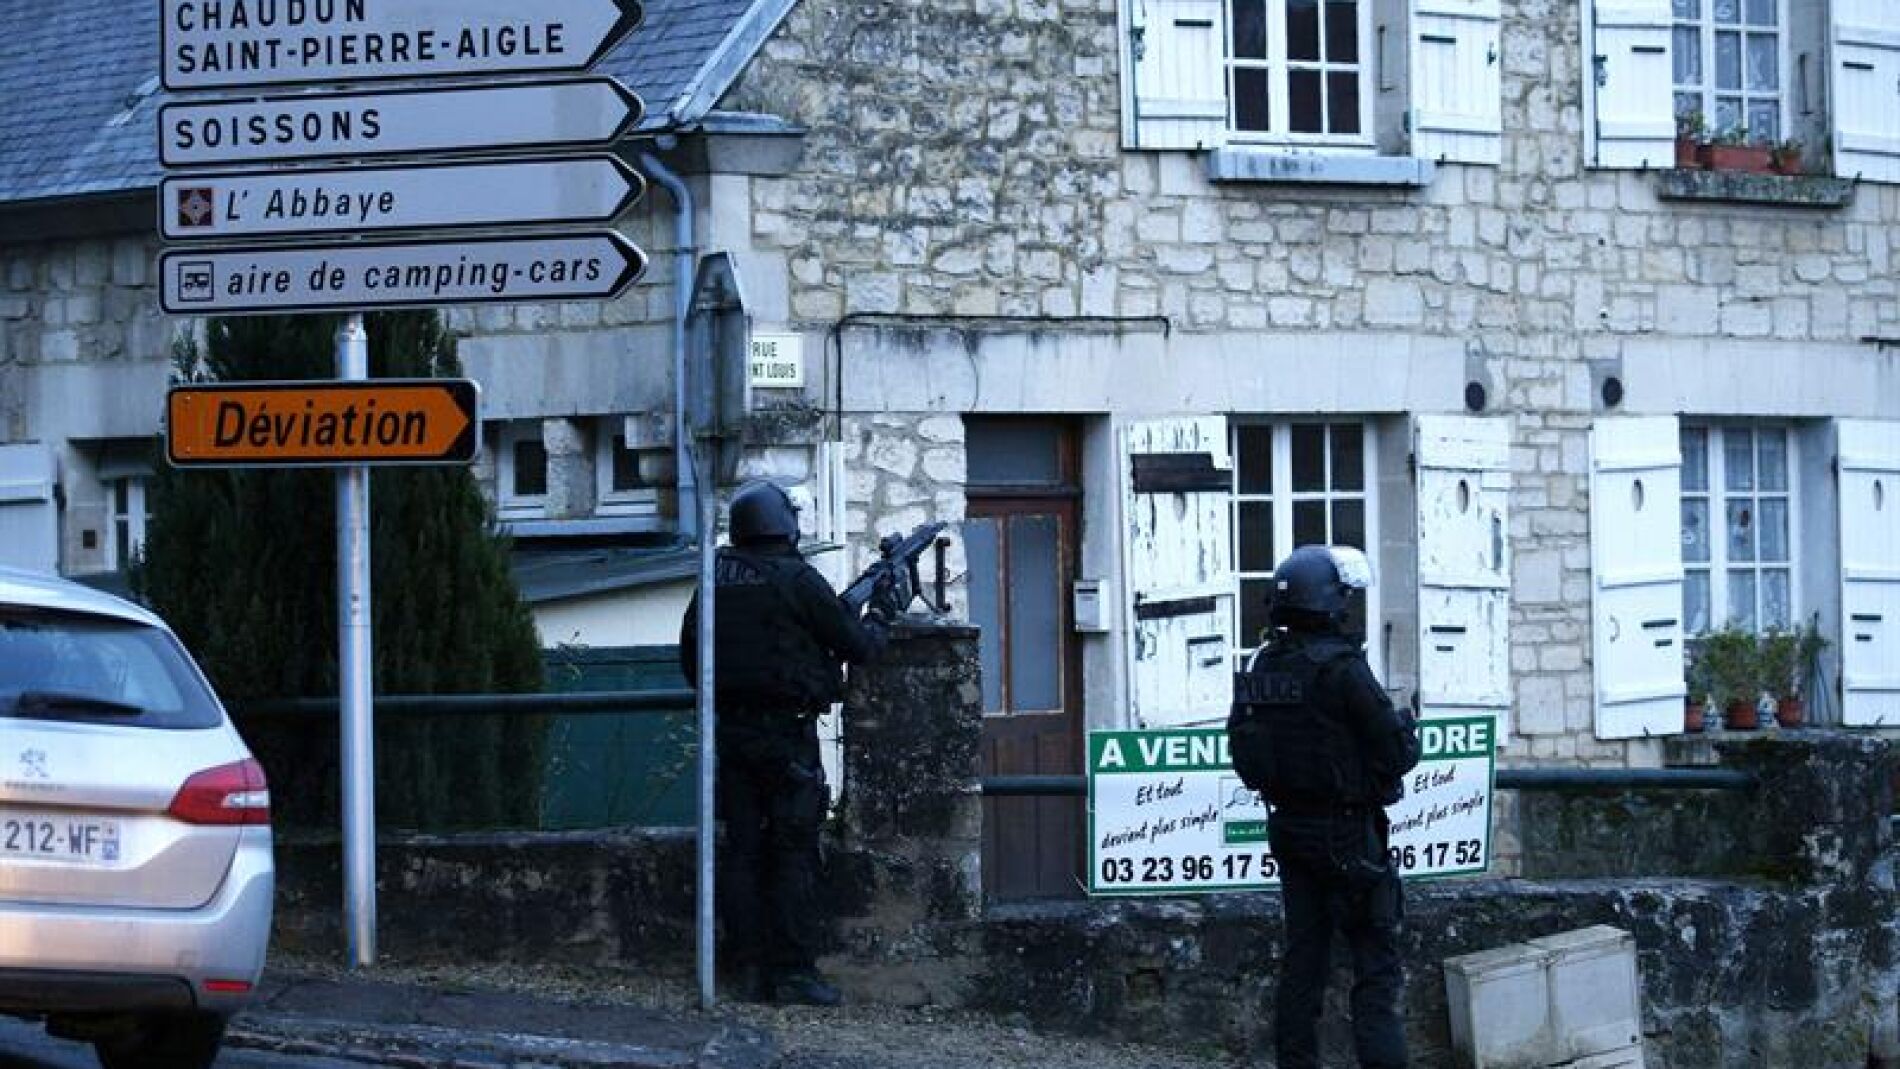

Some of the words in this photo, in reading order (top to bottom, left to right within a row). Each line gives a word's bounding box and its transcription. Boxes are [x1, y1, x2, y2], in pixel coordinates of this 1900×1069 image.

[177, 0, 365, 31] CHAUDUN
[177, 23, 565, 73] SAINT-PIERRE-AIGLE
[175, 108, 382, 149] SOISSONS
[226, 189, 249, 221] L'
[264, 187, 395, 222] Abbaye
[227, 264, 291, 295] aire
[309, 260, 345, 291] de
[364, 255, 602, 293] camping-cars
[753, 341, 777, 357] RUE
[753, 363, 765, 378] NT
[213, 398, 427, 448] Déviation
[1099, 738, 1127, 767] A
[1414, 724, 1488, 754] DRE
[1136, 784, 1152, 806] Et
[1156, 776, 1184, 800] tout
[1413, 773, 1428, 794] Et
[1432, 763, 1456, 787] tout
[1101, 821, 1148, 849] devient
[1150, 817, 1177, 844] plus
[1180, 803, 1219, 833] simple
[1390, 809, 1424, 835] evient
[1425, 803, 1448, 831] plus
[1450, 789, 1485, 817] simple
[1101, 857, 1134, 883] 03
[1142, 856, 1174, 882] 23
[1182, 854, 1214, 881] 96
[1222, 853, 1252, 880] 17
[1260, 853, 1281, 878] 5
[1423, 842, 1449, 868] 17
[1456, 838, 1481, 866] 52
